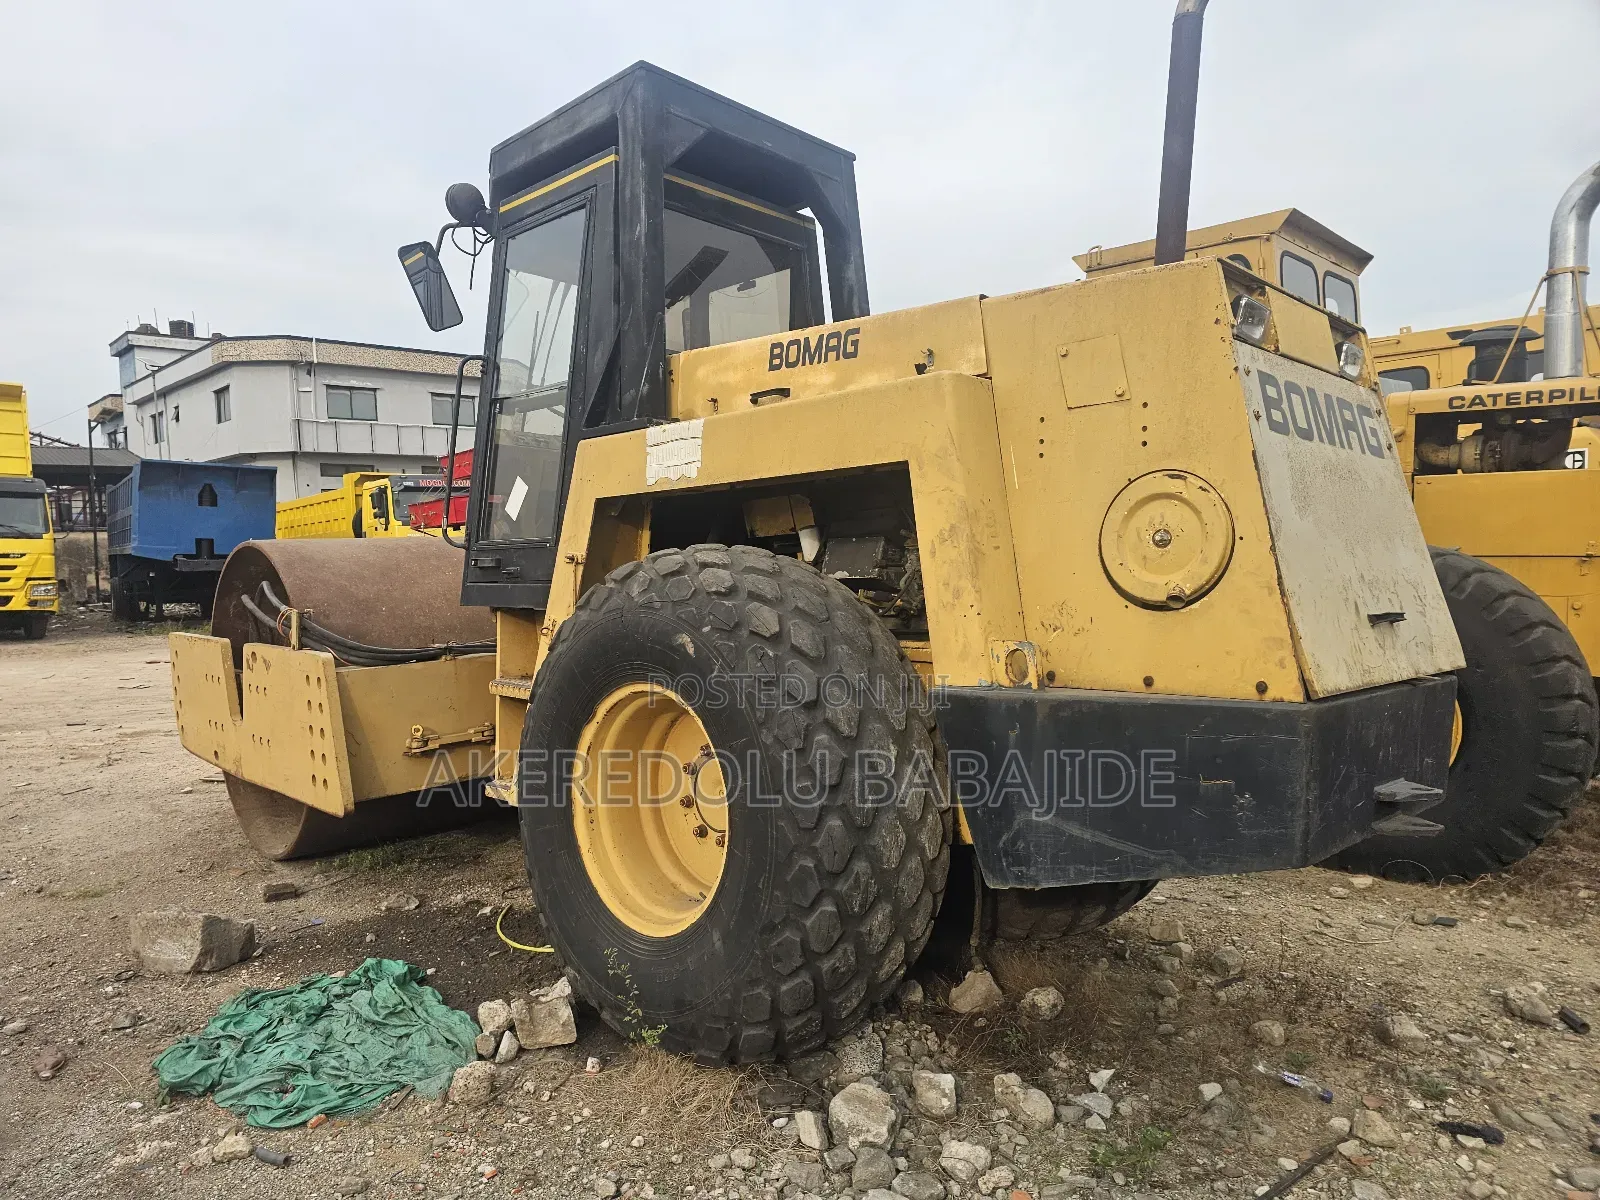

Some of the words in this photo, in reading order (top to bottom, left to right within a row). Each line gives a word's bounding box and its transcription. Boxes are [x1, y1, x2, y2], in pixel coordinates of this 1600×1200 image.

[768, 327, 860, 372] BOMAG
[1257, 369, 1385, 460] BOMAG
[1448, 386, 1600, 410] CATERPIL
